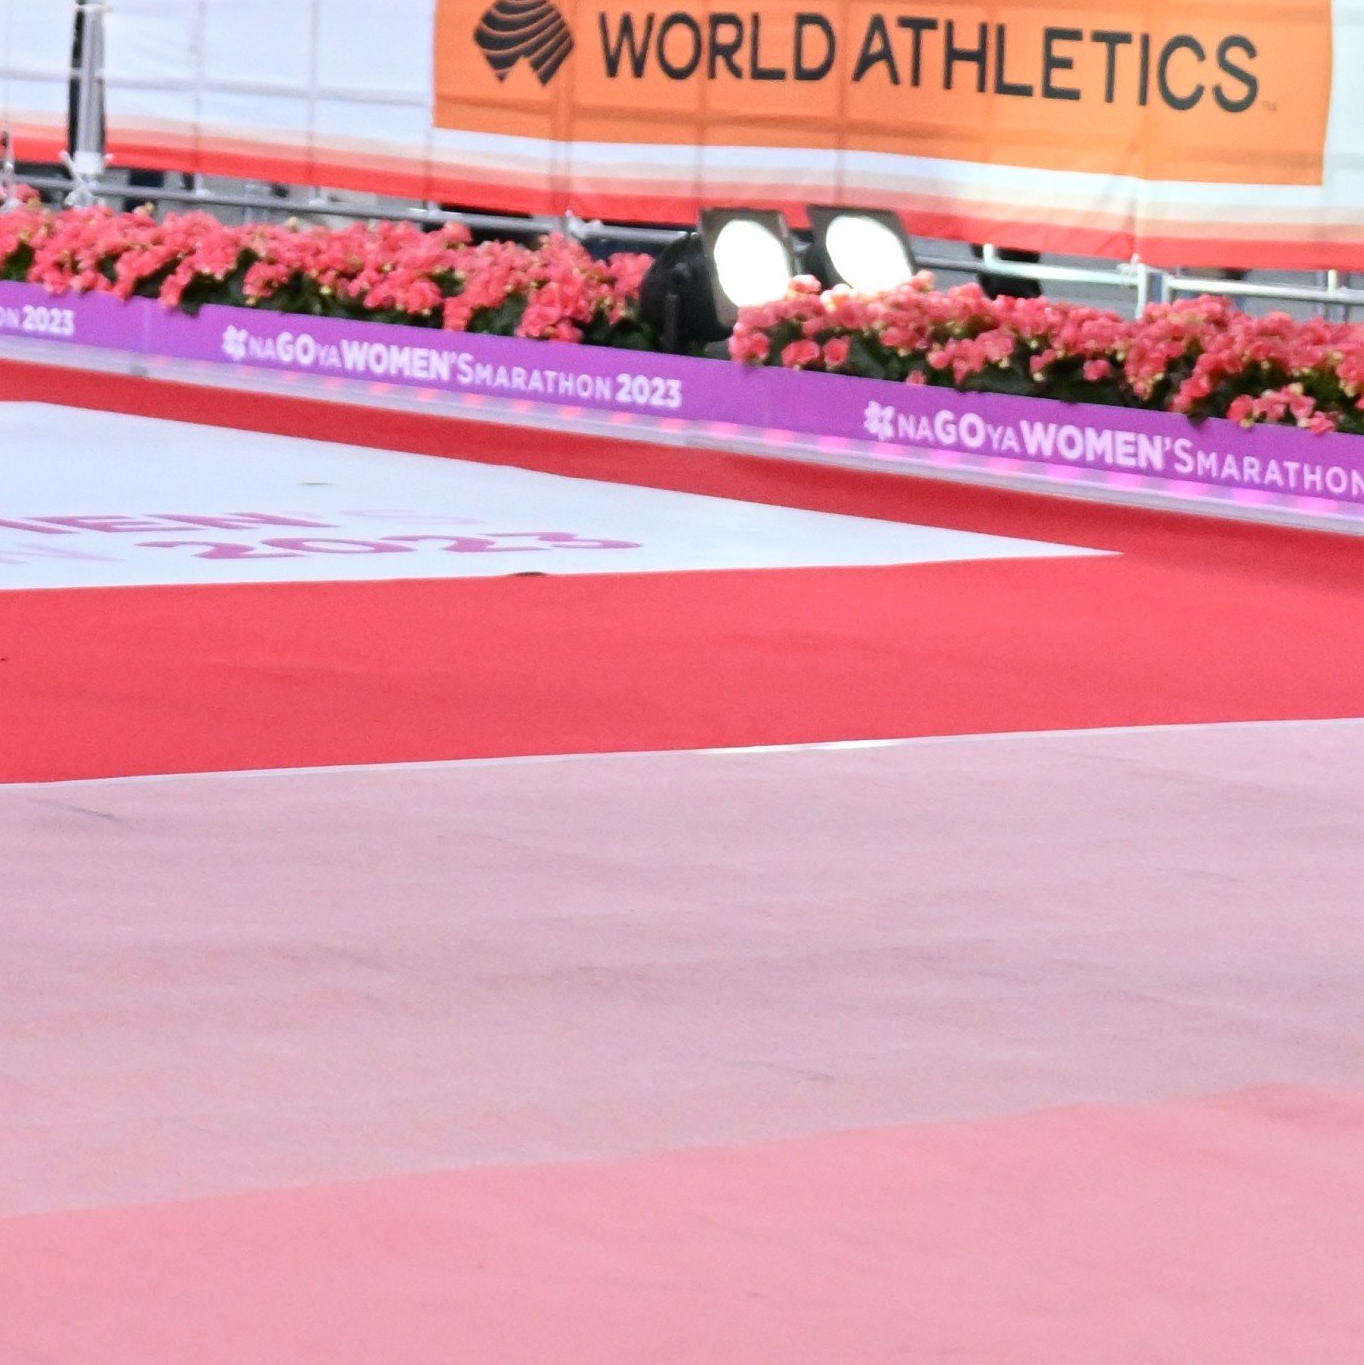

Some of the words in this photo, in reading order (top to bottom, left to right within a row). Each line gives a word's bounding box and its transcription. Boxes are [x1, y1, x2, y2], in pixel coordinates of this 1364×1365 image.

[597, 10, 836, 81] WORLD
[851, 13, 1259, 113] ATHLETICS
[22, 303, 76, 336] 2023
[339, 338, 475, 386] WOMEN'S
[472, 360, 613, 401] MARATHON
[615, 373, 684, 409] 2023
[1019, 419, 1195, 474] WOMEN'S
[133, 531, 644, 560] 2023
